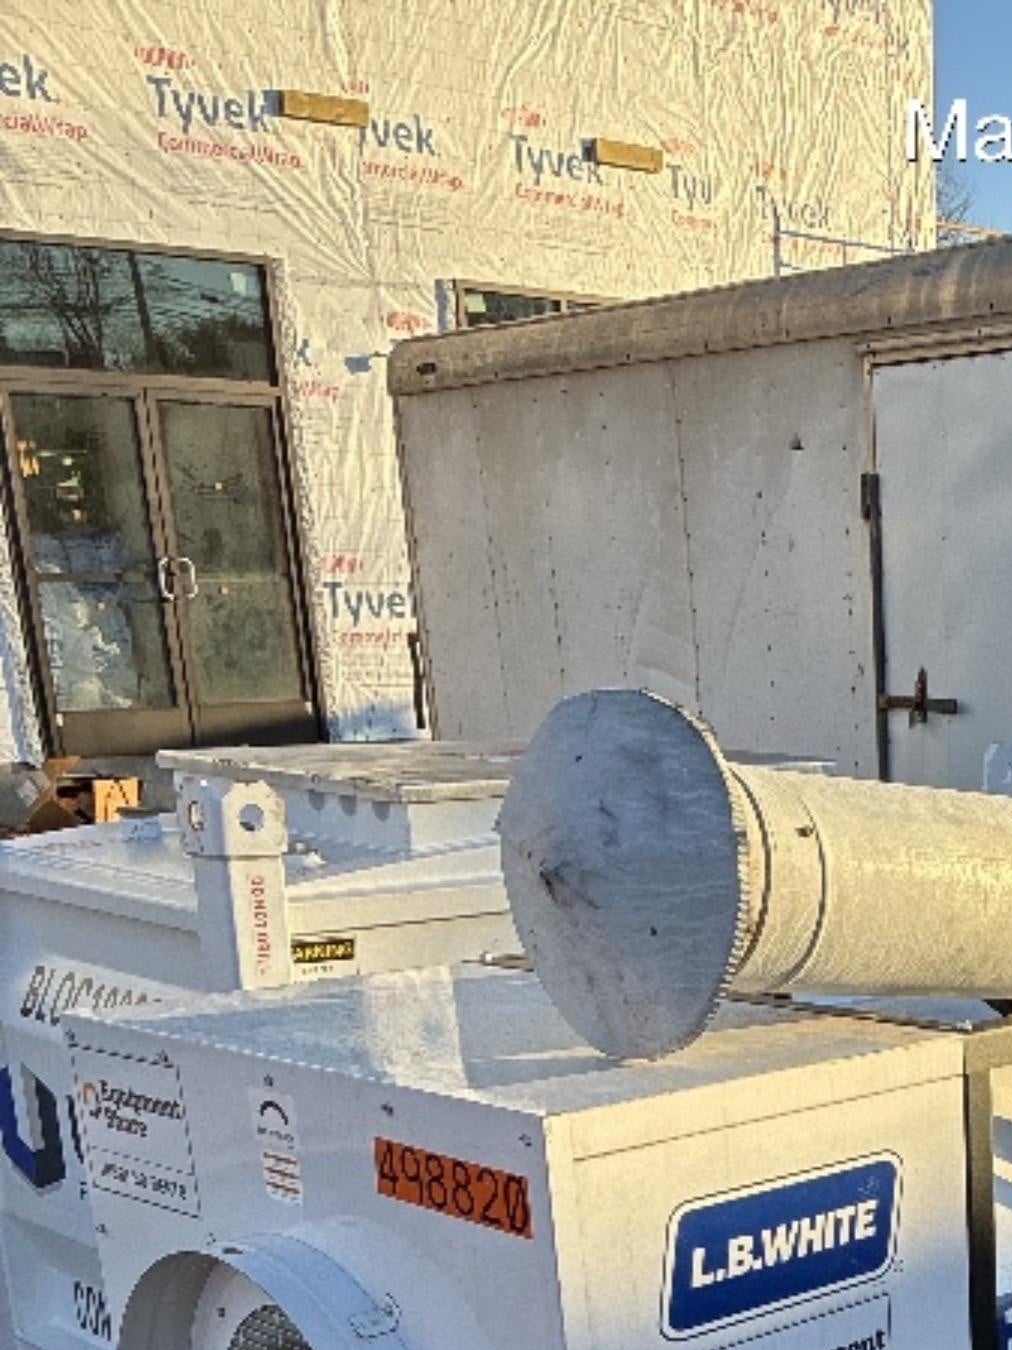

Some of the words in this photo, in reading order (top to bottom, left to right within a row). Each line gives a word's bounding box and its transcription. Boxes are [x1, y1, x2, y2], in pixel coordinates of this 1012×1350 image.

[146, 75, 269, 134] Tyvek
[378, 1142, 531, 1233] 498820
[690, 1199, 880, 1289] L.B.WHITE
